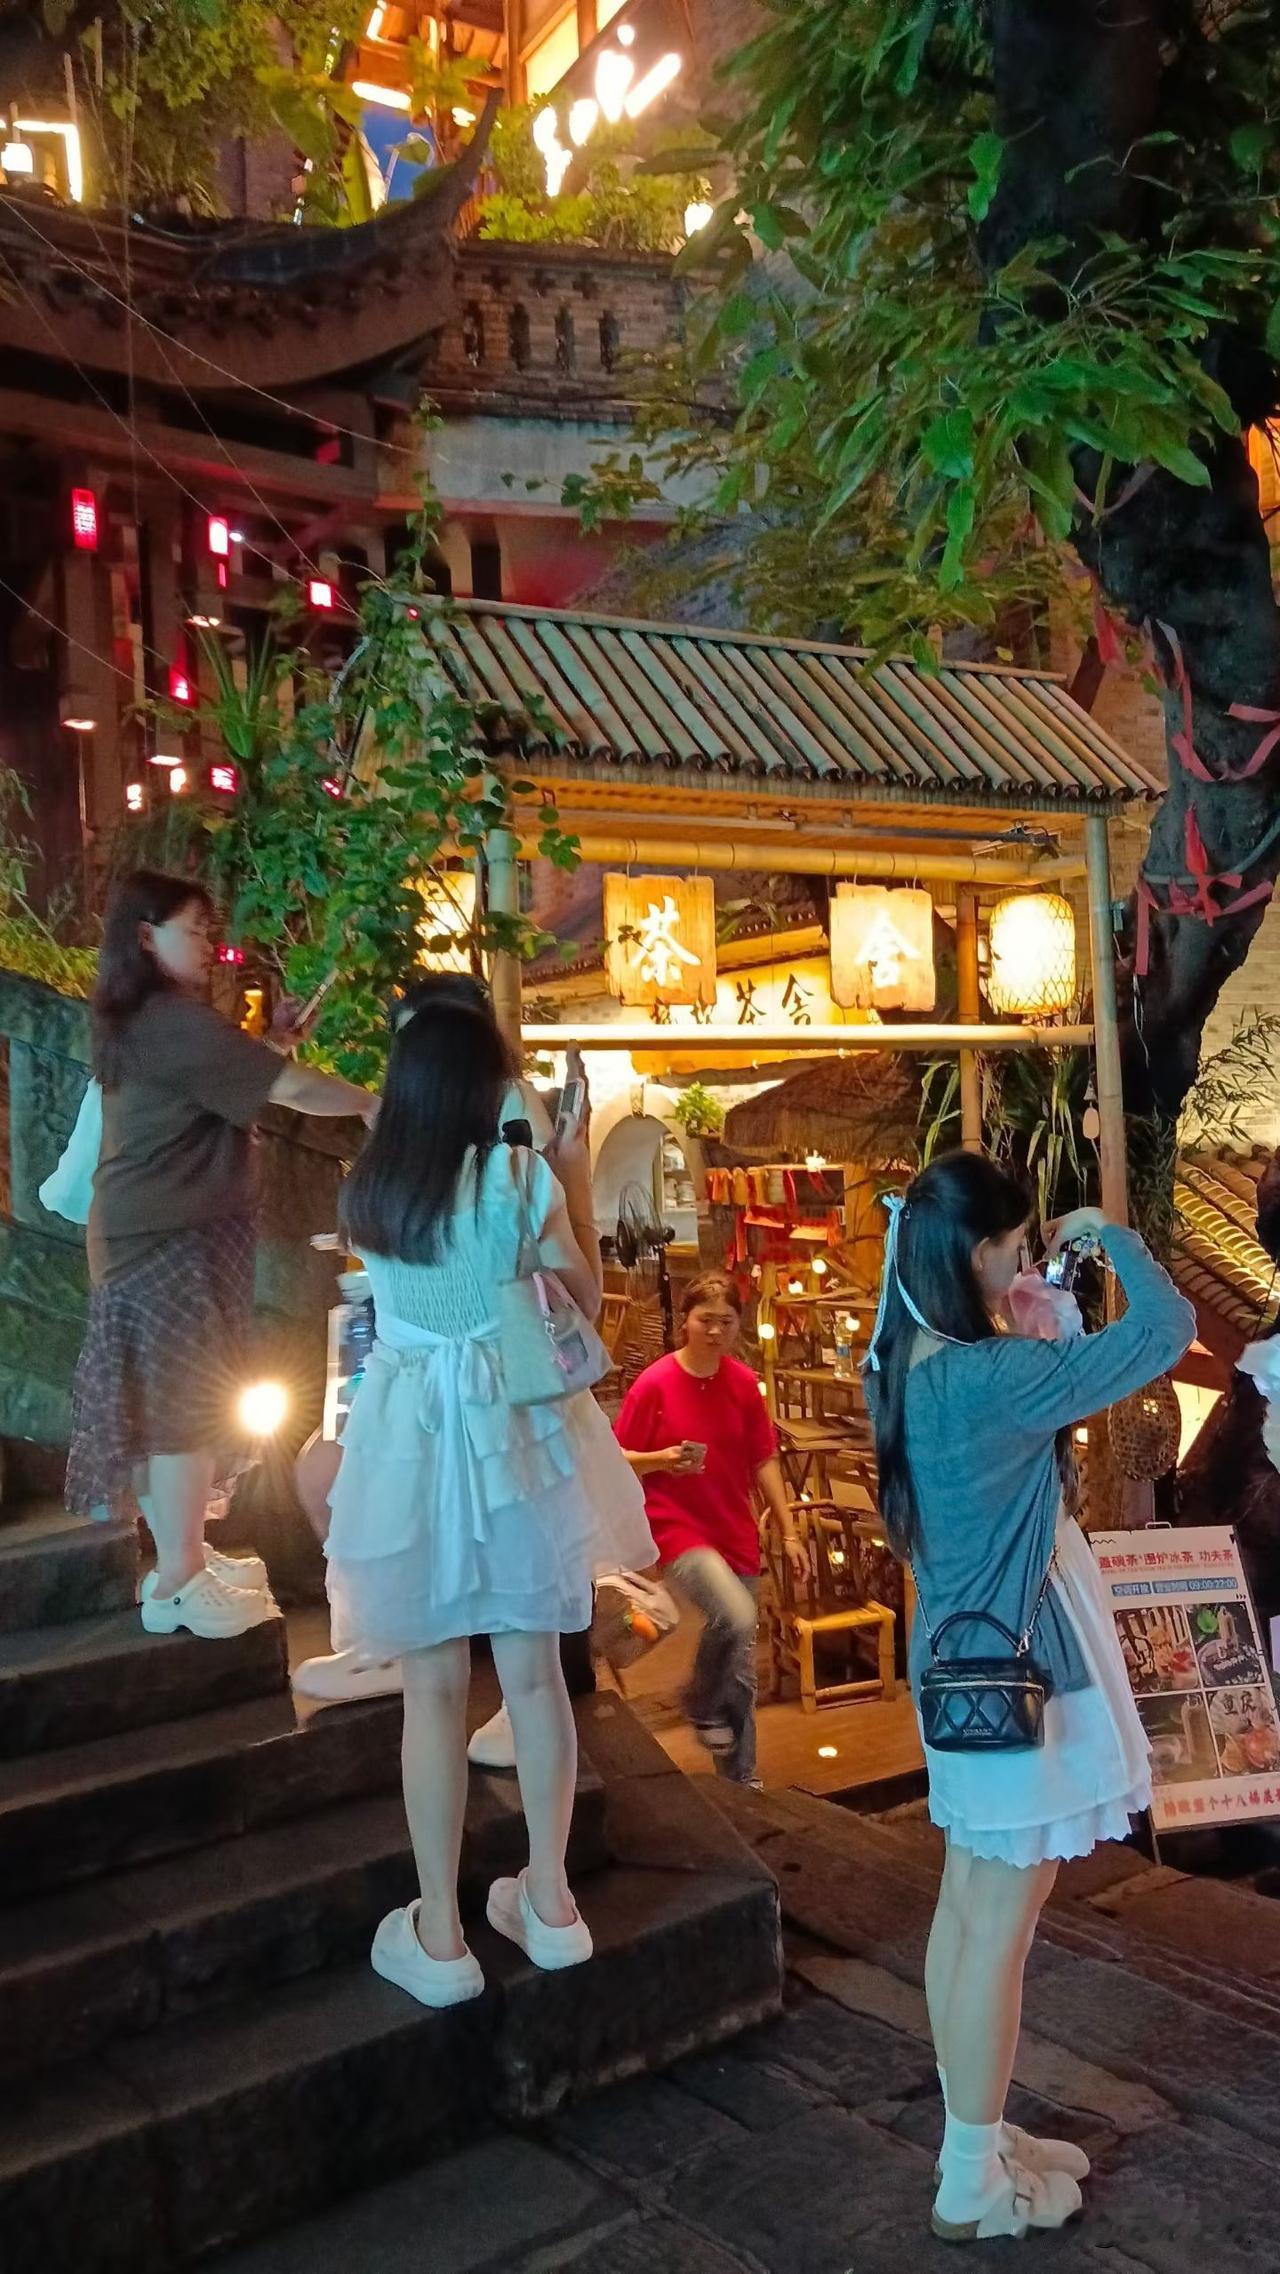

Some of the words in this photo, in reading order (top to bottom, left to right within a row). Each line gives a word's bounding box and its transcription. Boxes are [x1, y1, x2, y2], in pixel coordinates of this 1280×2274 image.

[631, 895, 702, 987] 茶
[854, 908, 922, 989] 舍
[1223, 1690, 1257, 1716] 重庆
